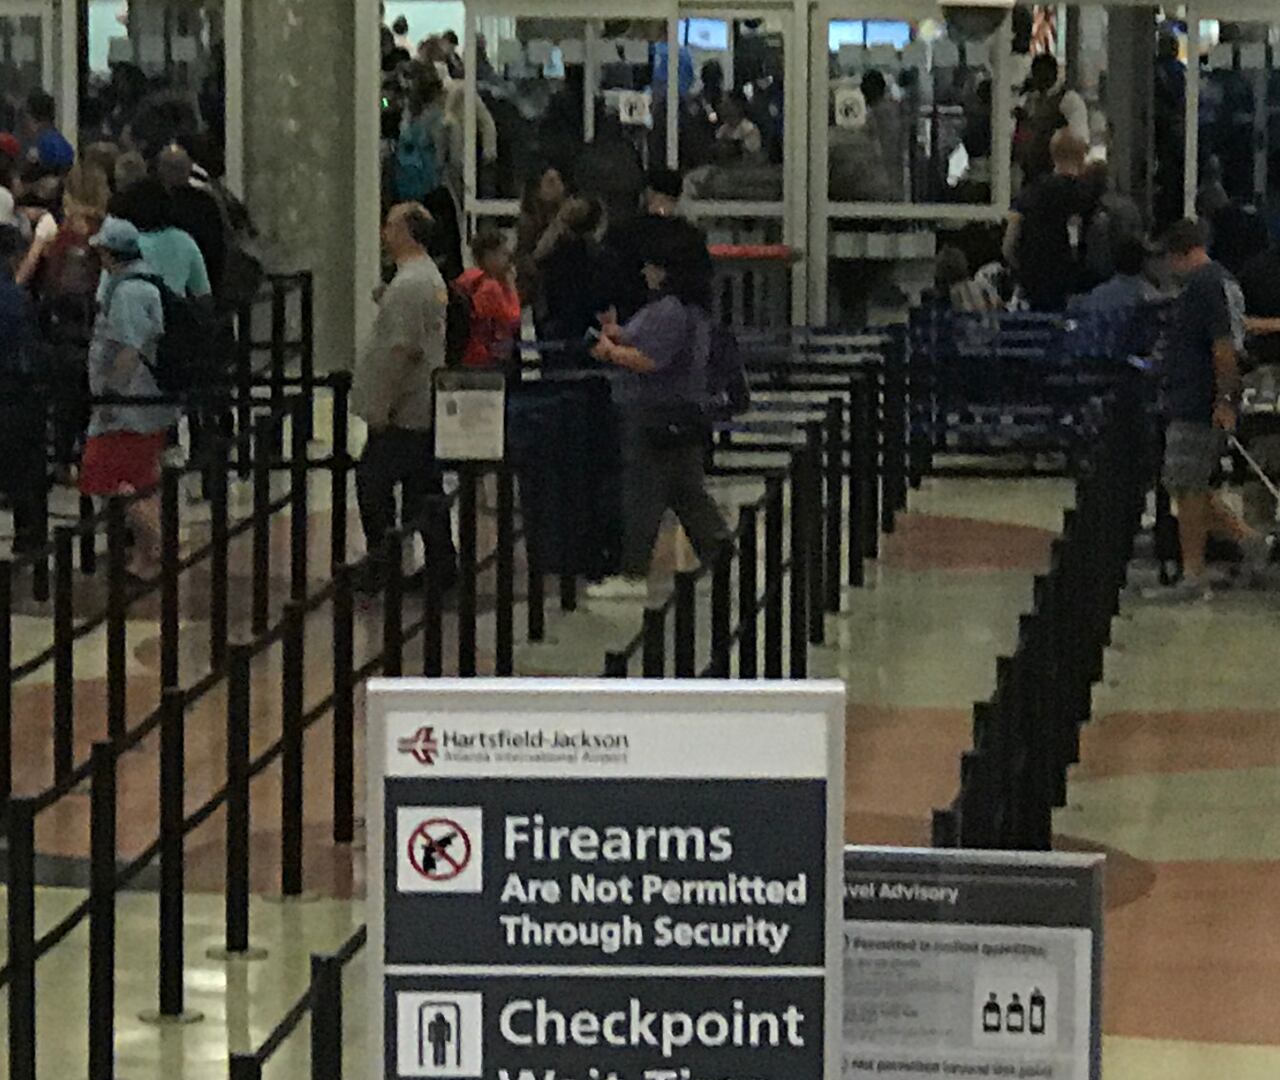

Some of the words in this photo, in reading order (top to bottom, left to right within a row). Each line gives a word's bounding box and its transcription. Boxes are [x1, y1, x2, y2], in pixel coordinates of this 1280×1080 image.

[439, 727, 632, 750] Hartsfield-Jackson
[504, 813, 733, 862] Firearms
[500, 873, 561, 904] Are
[570, 873, 634, 905] Not
[642, 872, 807, 905] Permitted
[879, 882, 959, 904] Advisory
[499, 913, 643, 954] Through
[654, 915, 790, 954] Security
[499, 997, 805, 1058] Checkpoint
